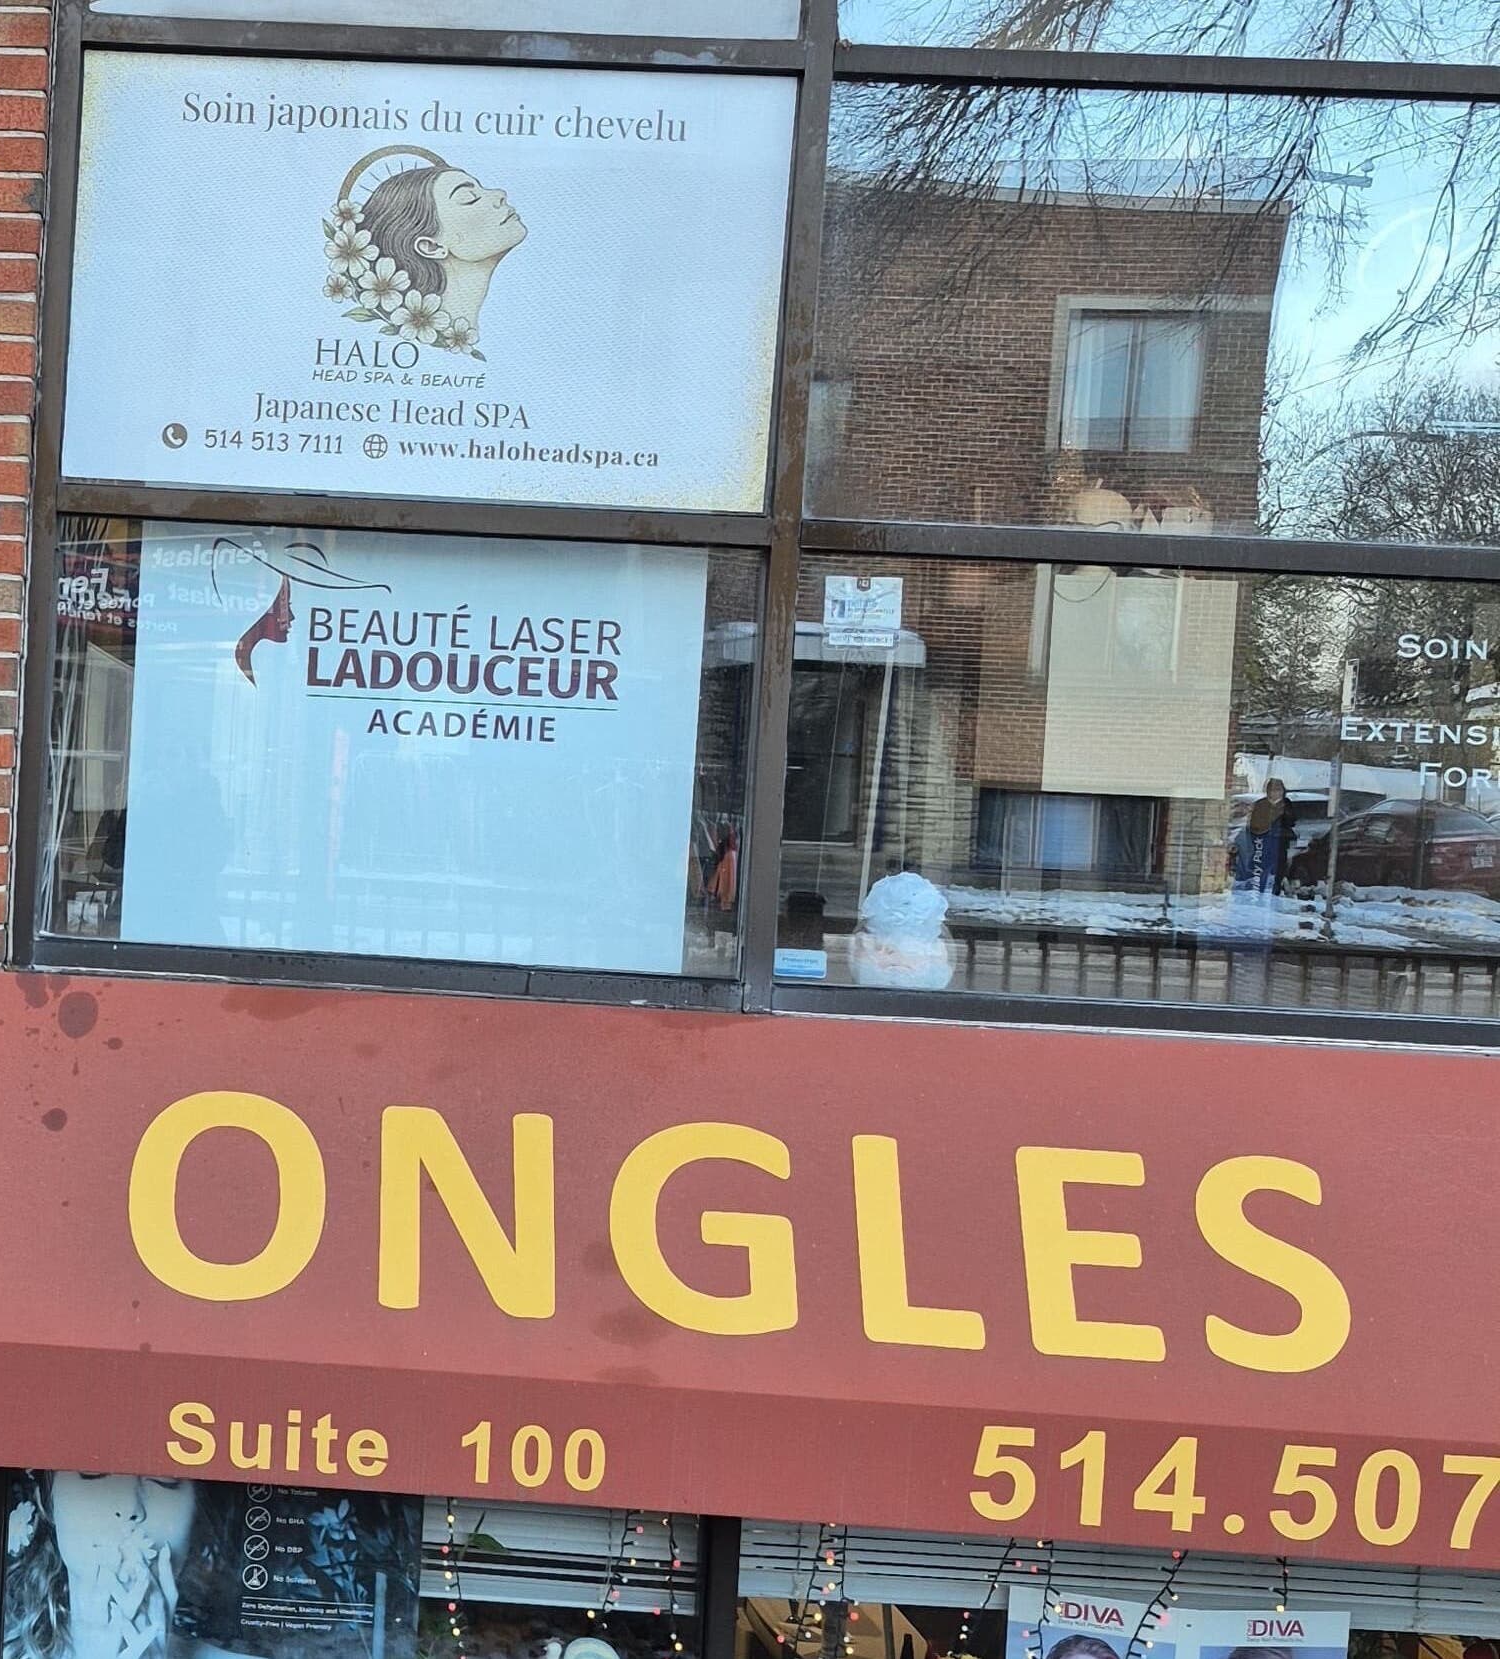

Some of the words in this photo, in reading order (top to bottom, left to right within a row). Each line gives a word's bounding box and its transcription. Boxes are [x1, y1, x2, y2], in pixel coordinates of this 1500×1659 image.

[182, 92, 256, 125] Soin
[264, 94, 409, 134] japonais
[420, 100, 463, 133] du
[474, 104, 544, 137] cuir
[554, 105, 687, 142] chevelu
[315, 338, 420, 369] HALO
[312, 369, 358, 383] HEAD
[363, 371, 394, 385] SPA
[400, 372, 413, 385] &
[420, 373, 487, 389] BEAUTÉ
[253, 392, 381, 424] Japanese
[389, 398, 465, 426] Head
[474, 402, 531, 430] SPA
[203, 429, 244, 449] 514
[251, 431, 290, 453] 513
[298, 433, 343, 455] 7111
[398, 438, 659, 469] www.haloheadspa.ca
[308, 603, 472, 649] BEAUTÉ
[489, 615, 622, 656] LASER
[1397, 633, 1488, 661] SOIN
[306, 646, 619, 700] LADOUCEUR
[366, 708, 557, 742] ACADÉMIE
[1419, 761, 1500, 789] FOR
[127, 1090, 1352, 1373] ONGLES
[165, 1402, 389, 1478] Suite
[460, 1420, 607, 1492] 100
[969, 1425, 1500, 1551] 514.507
[1064, 1602, 1125, 1627] DIVA
[1251, 1619, 1305, 1637] DIVA
